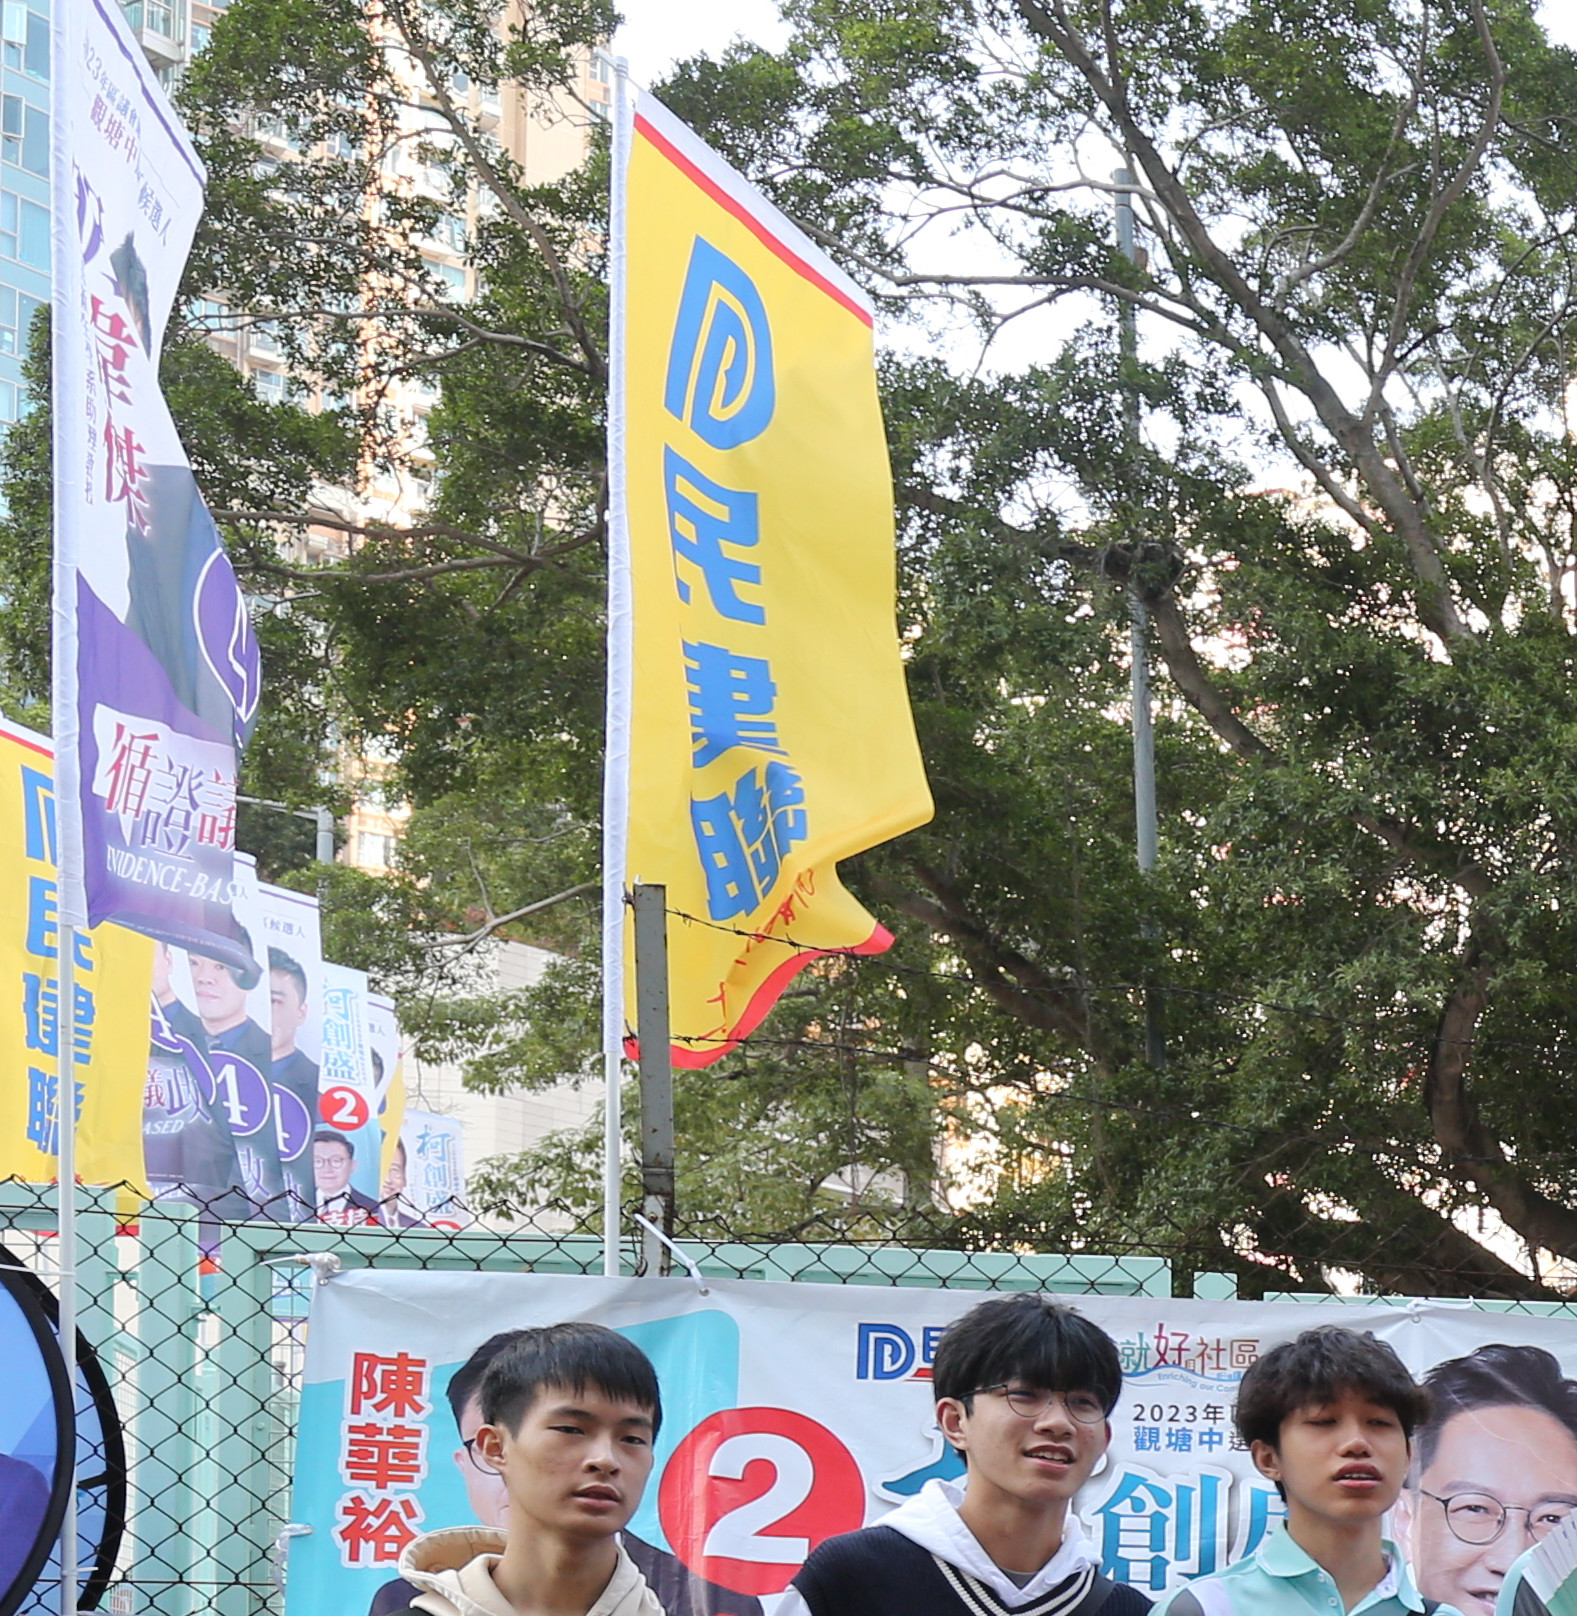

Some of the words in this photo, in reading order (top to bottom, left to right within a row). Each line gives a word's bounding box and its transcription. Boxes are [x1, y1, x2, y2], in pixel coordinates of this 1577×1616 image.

[333, 1091, 358, 1123] 2
[416, 1125, 452, 1215] 柯創盛
[1157, 1373, 1197, 1388] Enriching
[1200, 1383, 1213, 1391] our
[1132, 1403, 1238, 1425] 2023年
[341, 1352, 427, 1562] 陳華裕
[704, 1433, 814, 1562] 2
